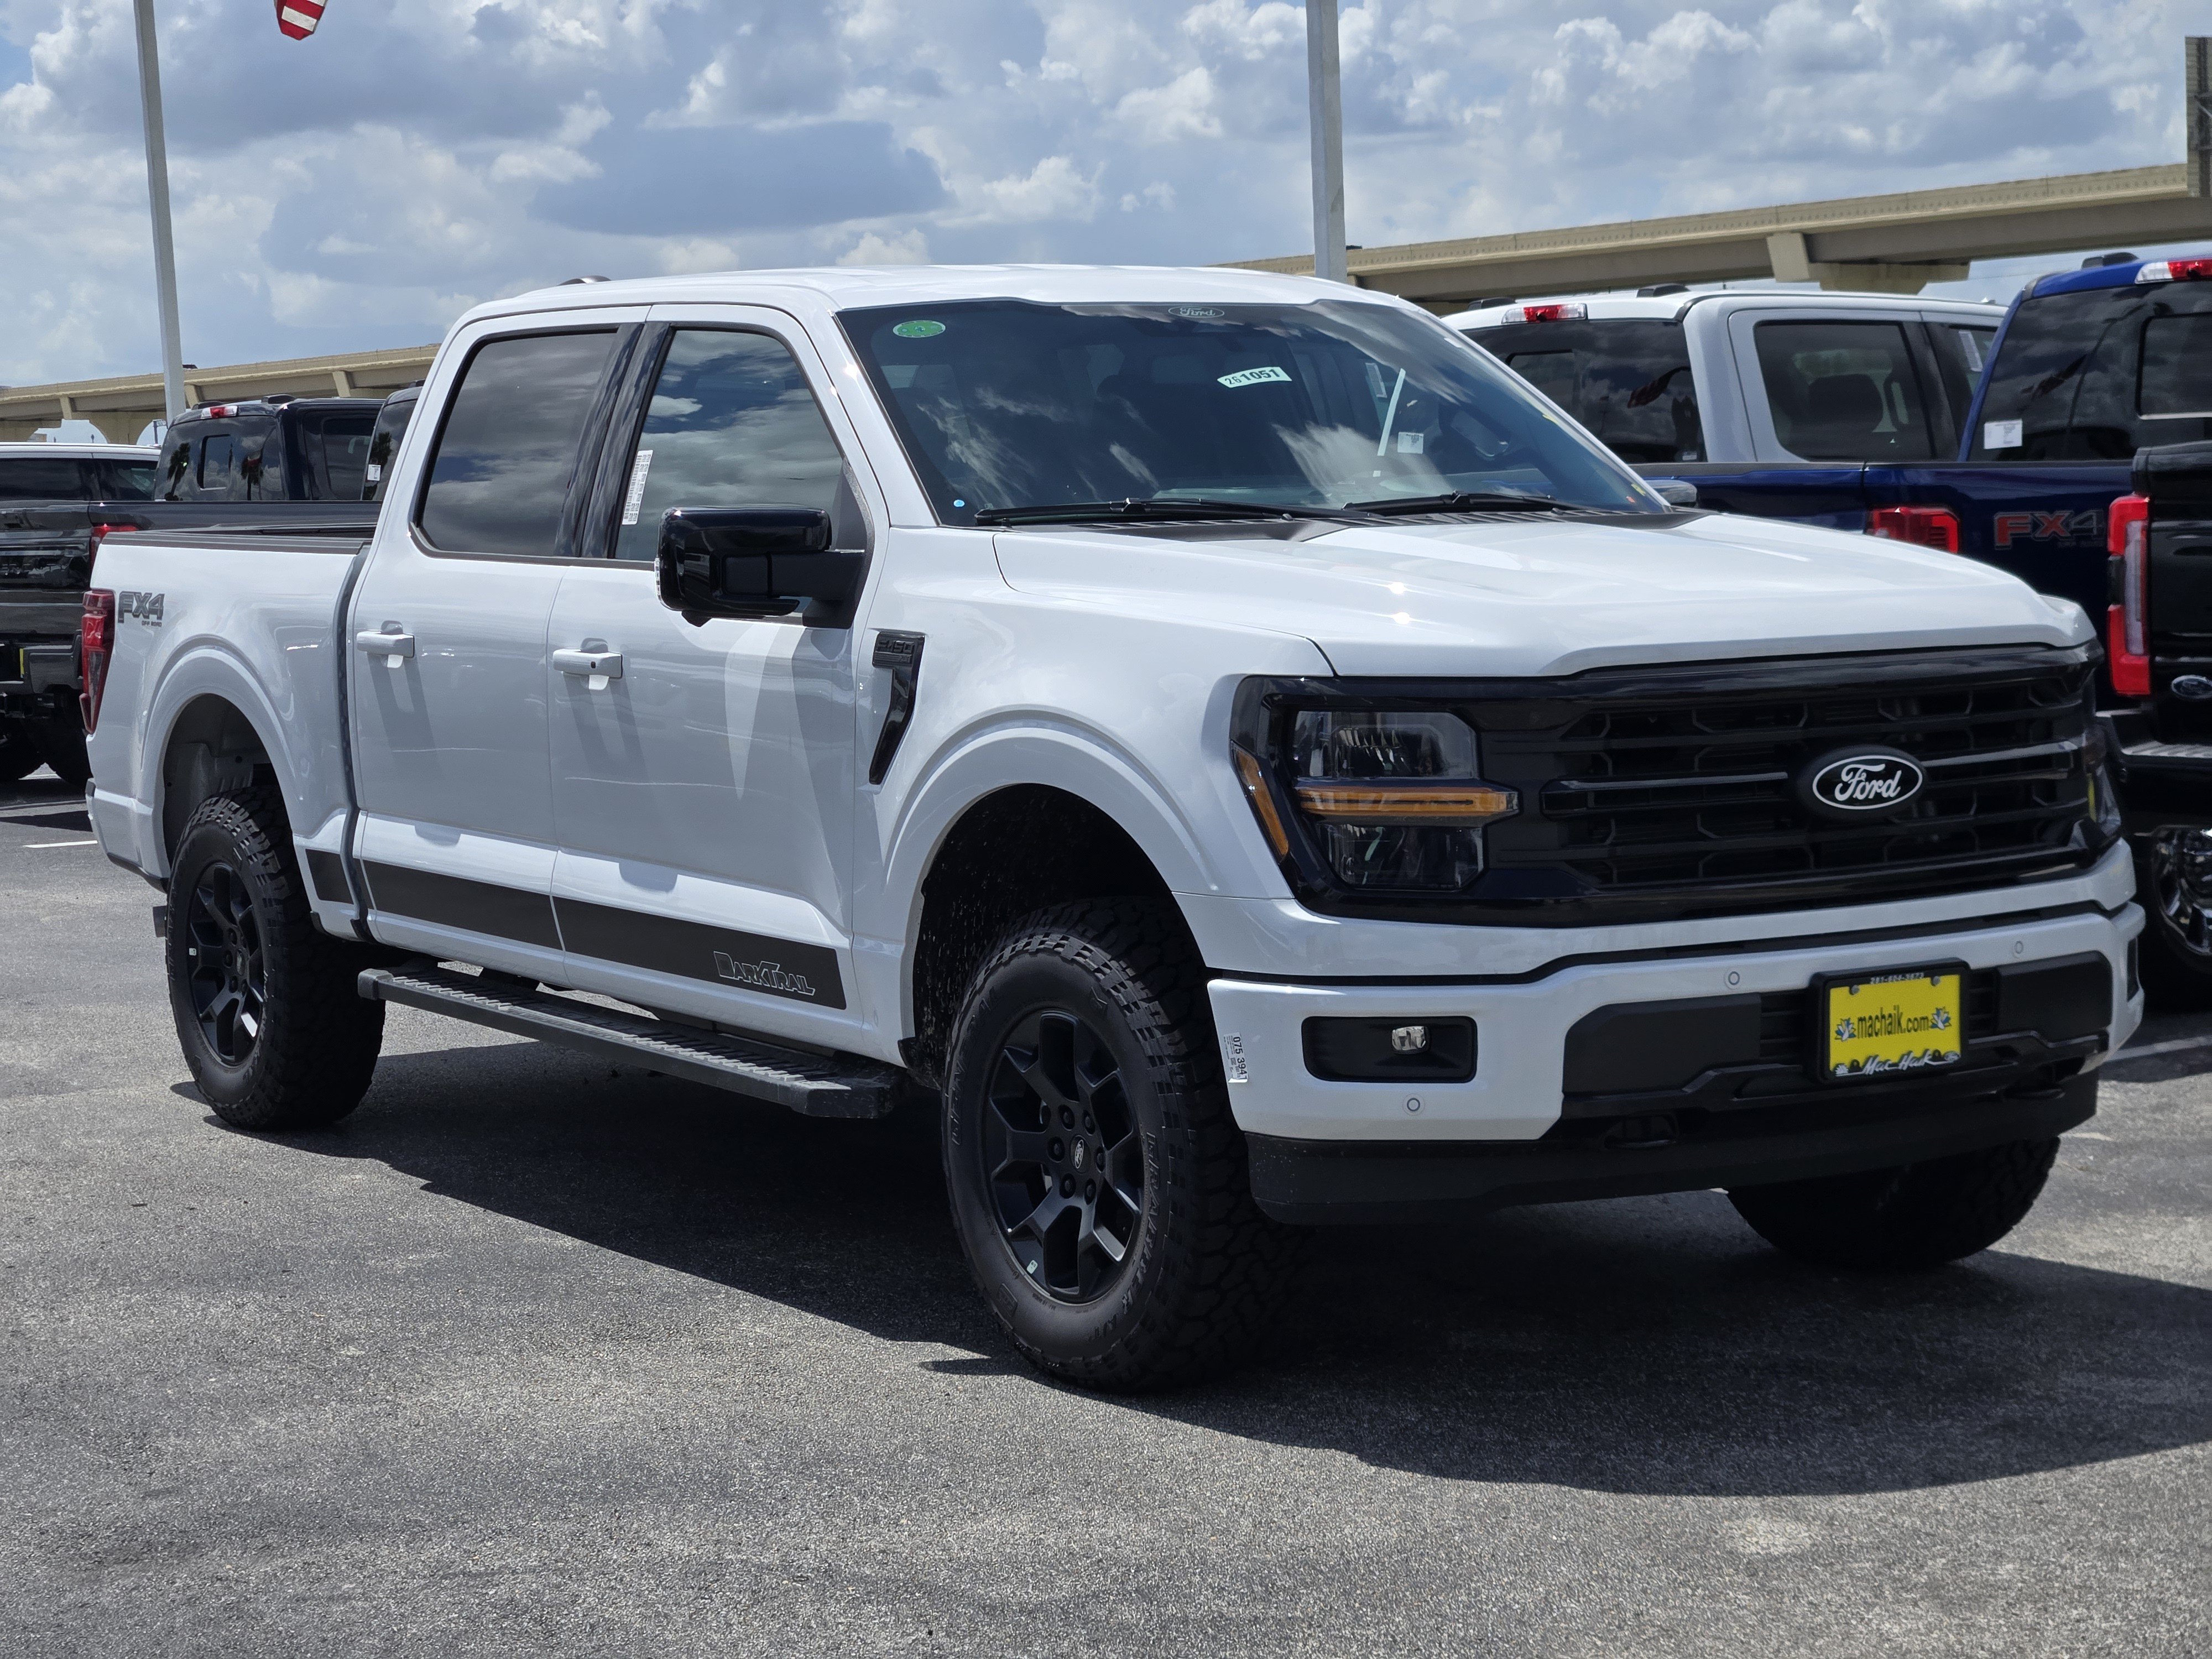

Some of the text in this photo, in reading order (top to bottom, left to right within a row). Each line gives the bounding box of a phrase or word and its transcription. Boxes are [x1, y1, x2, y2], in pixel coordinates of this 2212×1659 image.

[1179, 307, 1215, 316] Ford
[1993, 509, 2104, 550] FX4
[118, 591, 165, 624] FX4
[1834, 764, 1902, 801] Ford
[1857, 1005, 1929, 1039] machaik.com
[1233, 1036, 1244, 1054] 075
[1863, 1055, 1893, 1075] Mac
